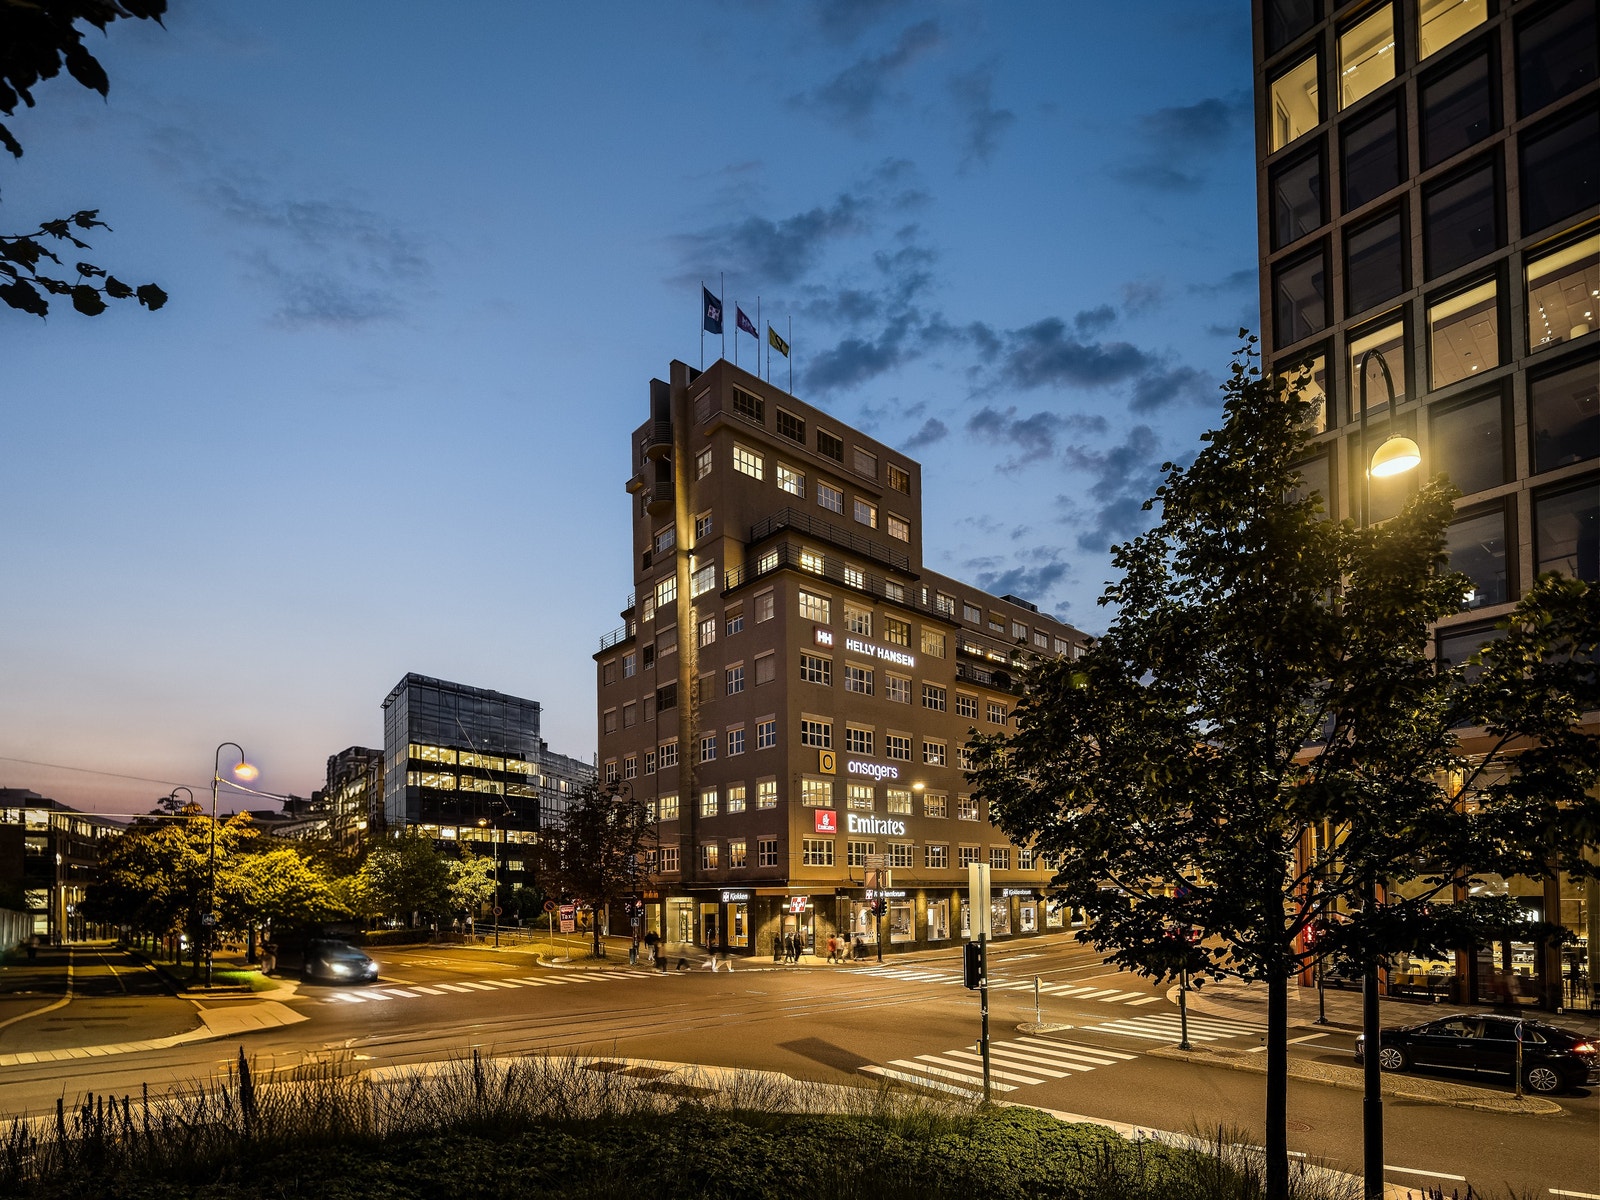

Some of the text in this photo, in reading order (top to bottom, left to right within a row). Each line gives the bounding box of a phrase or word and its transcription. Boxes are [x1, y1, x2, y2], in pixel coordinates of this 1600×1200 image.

[817, 630, 833, 646] HH
[846, 638, 915, 668] HELLY HANSEN
[848, 760, 899, 781] onsagers
[847, 813, 906, 836] Emirates
